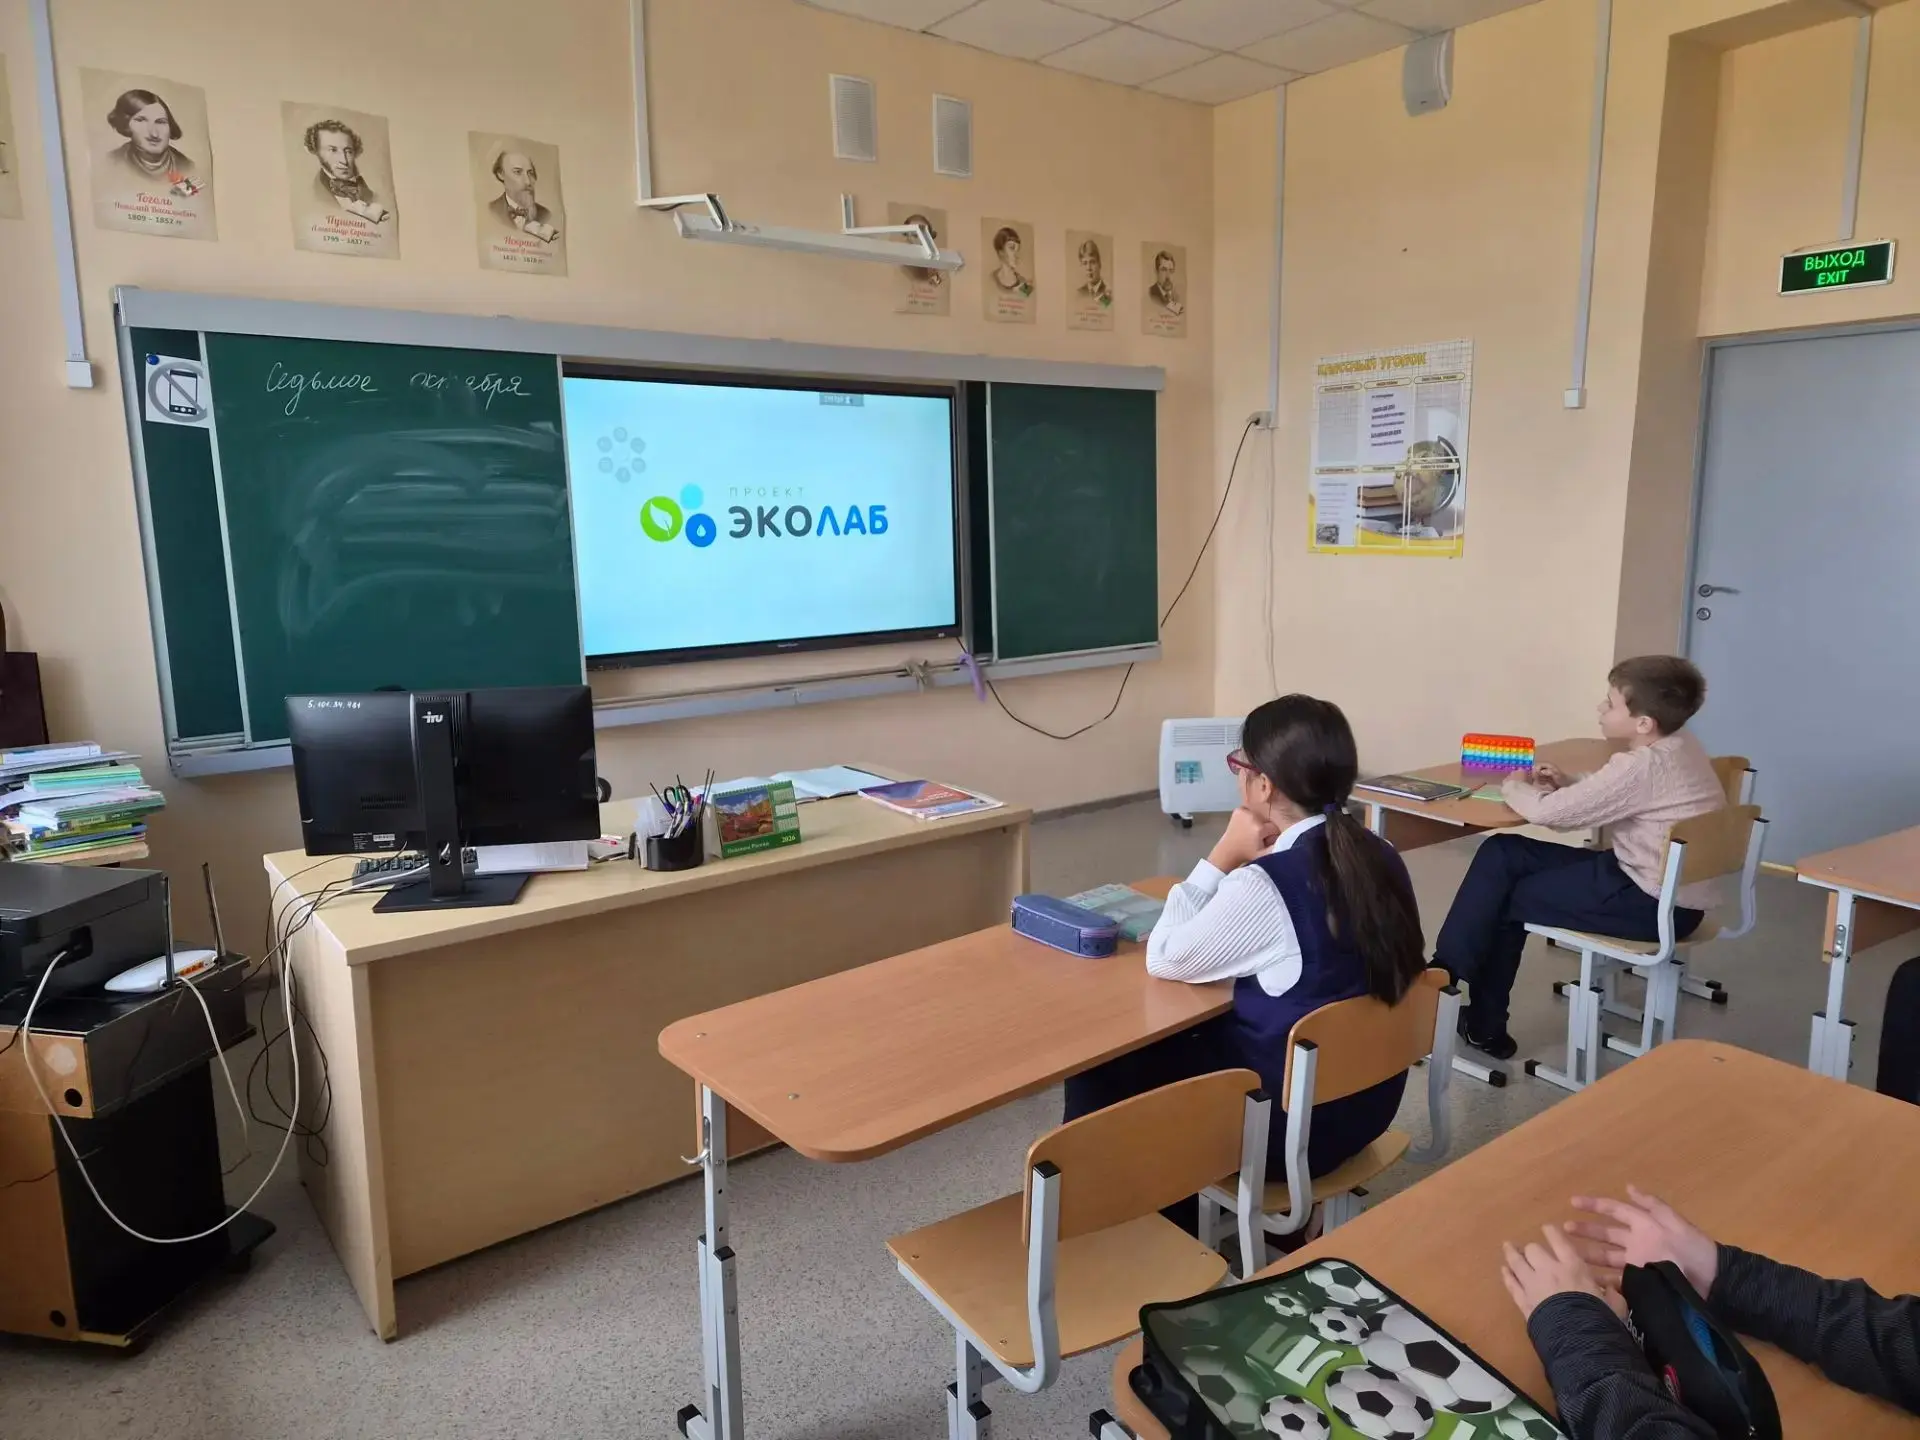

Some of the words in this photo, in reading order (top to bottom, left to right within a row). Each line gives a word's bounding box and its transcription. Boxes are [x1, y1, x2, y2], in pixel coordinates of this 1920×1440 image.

[136, 192, 173, 206] Гоголь
[128, 213, 146, 222] 1809
[155, 216, 174, 225] 1852
[326, 215, 367, 229] Пушкин
[1804, 249, 1866, 272] ВЫХОД
[1816, 269, 1850, 286] EXIT
[266, 361, 379, 416] Седьмое
[729, 486, 804, 498] ПРОЕКТ
[728, 504, 889, 539] ЭКОЛАБ
[781, 834, 796, 843] 2026
